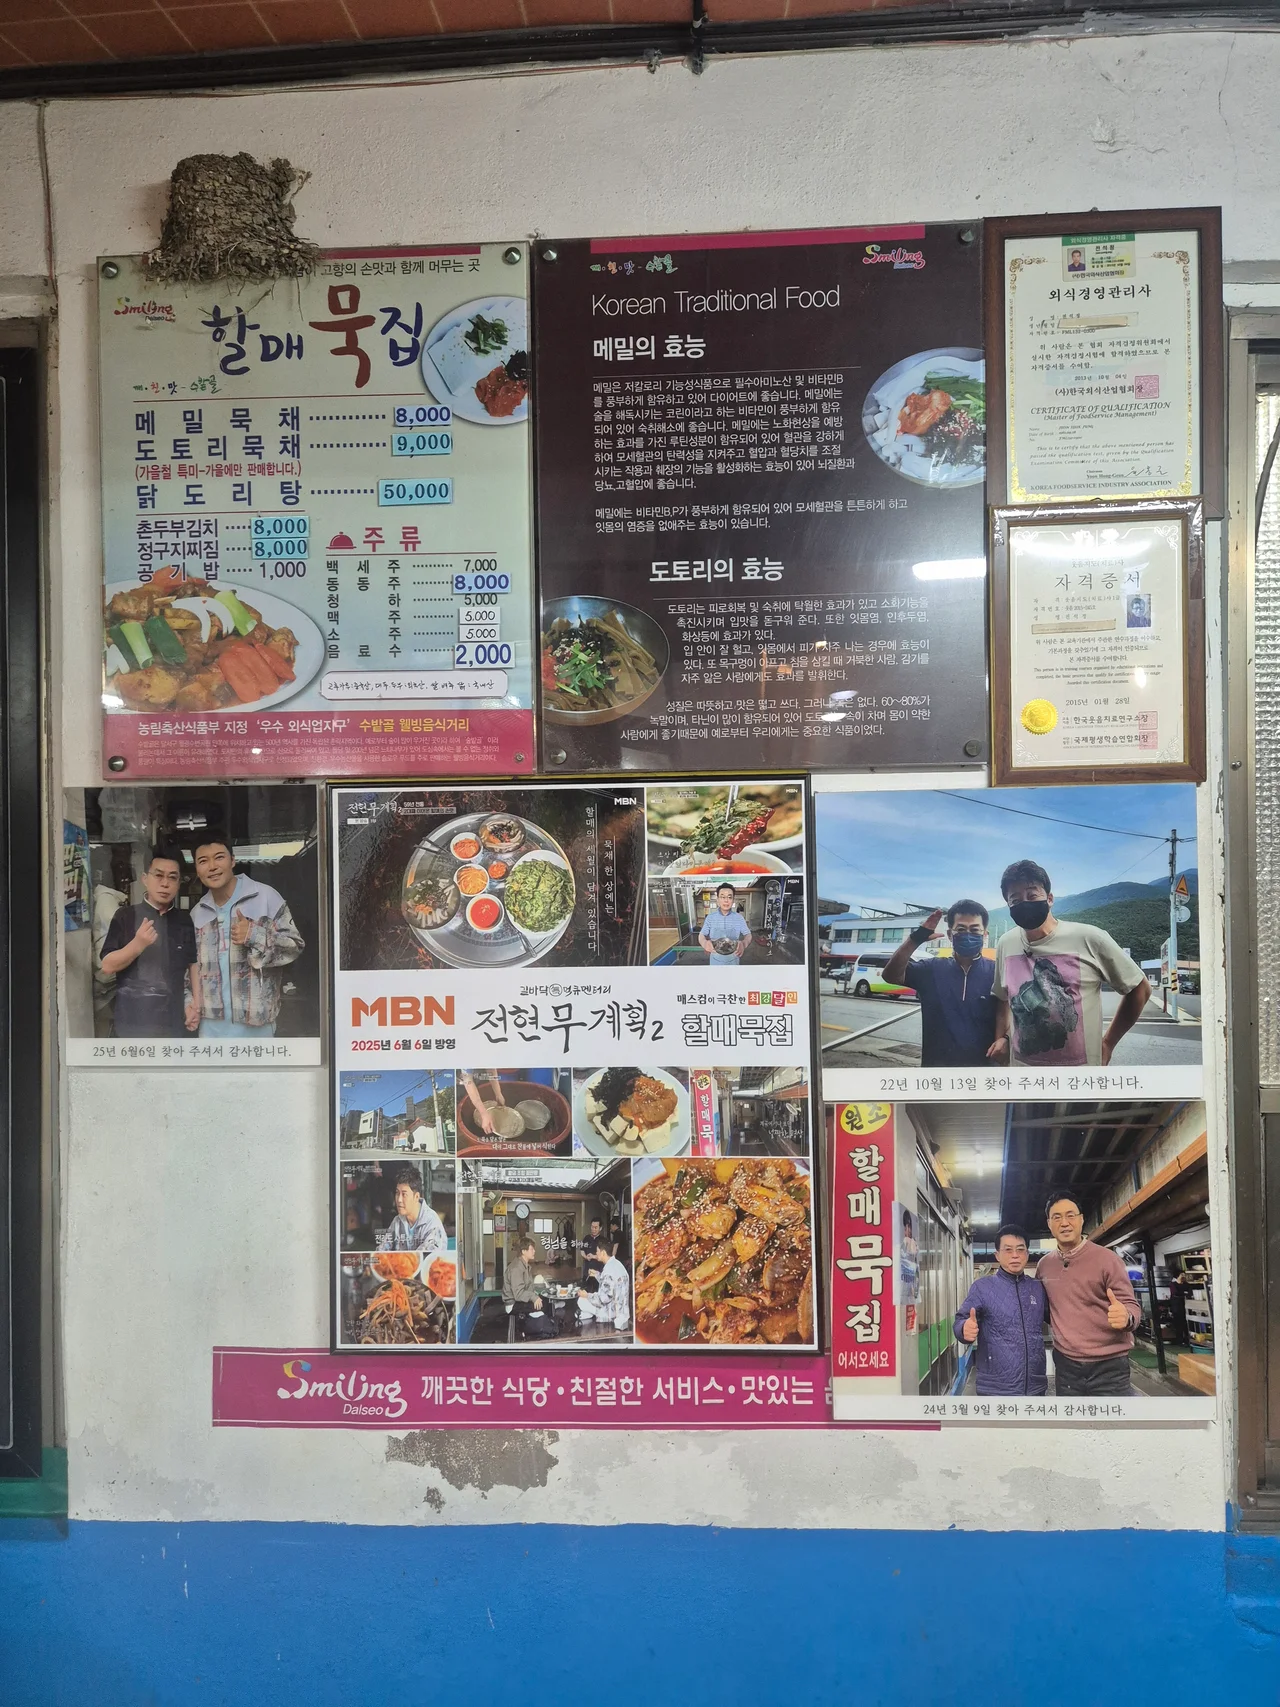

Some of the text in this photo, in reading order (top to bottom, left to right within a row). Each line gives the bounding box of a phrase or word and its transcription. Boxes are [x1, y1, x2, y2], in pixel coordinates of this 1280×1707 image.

[863, 244, 926, 269] Smiling
[321, 260, 355, 277] 고향의
[360, 261, 396, 275] 손맛과
[400, 260, 423, 274] 함께
[429, 259, 463, 273] 머무는
[468, 258, 480, 272] 곳
[592, 284, 839, 316] Korean Traditional Food
[1049, 284, 1151, 302] 외식경영관리사
[594, 334, 705, 361] 메밀의 효능
[593, 373, 843, 394] 메밀은 저칼로리 기능성식품으로 필수아미노산 및 비타민B
[606, 395, 643, 407] 풍부하게
[647, 393, 684, 405] 함유하고
[688, 392, 706, 404] 있어
[710, 391, 757, 403] 다이어트에
[760, 389, 800, 402] 좋습니다.
[804, 387, 842, 403] 메밀에는
[393, 406, 453, 427] 8,000
[593, 400, 840, 421] 술을 해독시키는 코린이라고 하는 비타민이 풍부하게 함유
[1030, 401, 1170, 416] CERTIFICATE OF QUALIFICATION
[397, 433, 452, 455] 9,000
[384, 482, 448, 501] 50,000
[1054, 482, 1095, 490] FOODSERVICE
[1130, 479, 1171, 487] ASSOCIATION
[136, 516, 306, 539] 촌두부김치 8,000
[137, 537, 306, 560] 정구지찌짐 8,000
[260, 560, 305, 580] 1,000
[464, 558, 496, 572] 7,000
[649, 556, 784, 583] 도토리의 효능
[453, 574, 508, 594] 8,000
[462, 592, 499, 609] 5,000
[668, 597, 928, 615] 도토리는 피로회복 및 숙취에 탁월한 효과가 있고 소화기능을
[682, 629, 775, 643] 화상등에 효과가 있다.
[454, 641, 510, 669] 2,000
[1066, 696, 1129, 706] 2015년 01월 28일
[138, 719, 219, 735] 농림축산식품부
[224, 720, 247, 734] 지정
[399, 718, 471, 731] 웰빙음식거리
[586, 807, 598, 952] 할매의 세월이 담겨 있습니다
[677, 990, 799, 1006] 매스컴이 극찬한 최강달인
[352, 993, 456, 1029] MBN
[681, 1013, 792, 1046] 할매묵집
[93, 1045, 290, 1057] 25년 6월6일 찾아 주셔서 감사합니다.
[351, 1038, 455, 1050] 2025년 6월 6일 방영
[880, 1075, 1142, 1091] 22년 10월 13일 찾아 주셔서 감사합니다.
[836, 1144, 893, 1344] 할매묵집
[838, 1350, 888, 1369] 어서오세요
[277, 1360, 407, 1418] Smiling
[421, 1376, 493, 1404] 깨끗한
[343, 1403, 384, 1415] Dalseo
[923, 1403, 1125, 1416] 24년 3월 9일 찾아 주셔서 감사합니다.
